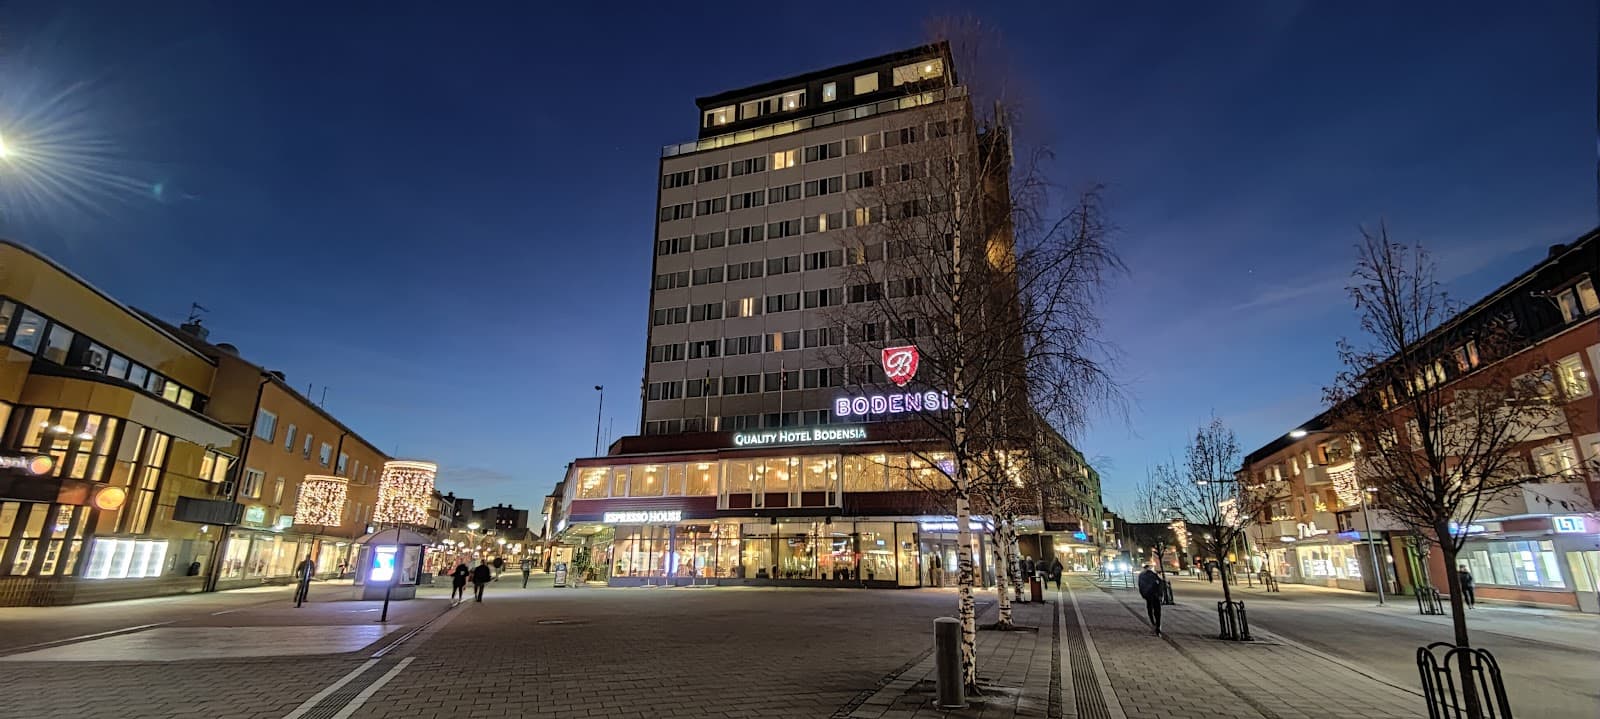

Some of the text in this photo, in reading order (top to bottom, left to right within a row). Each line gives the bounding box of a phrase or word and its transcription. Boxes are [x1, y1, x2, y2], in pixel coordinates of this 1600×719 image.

[735, 427, 866, 446] QUALITY HOTEL BODENSIA
[603, 509, 682, 523] ESPRESSO HOUSE
